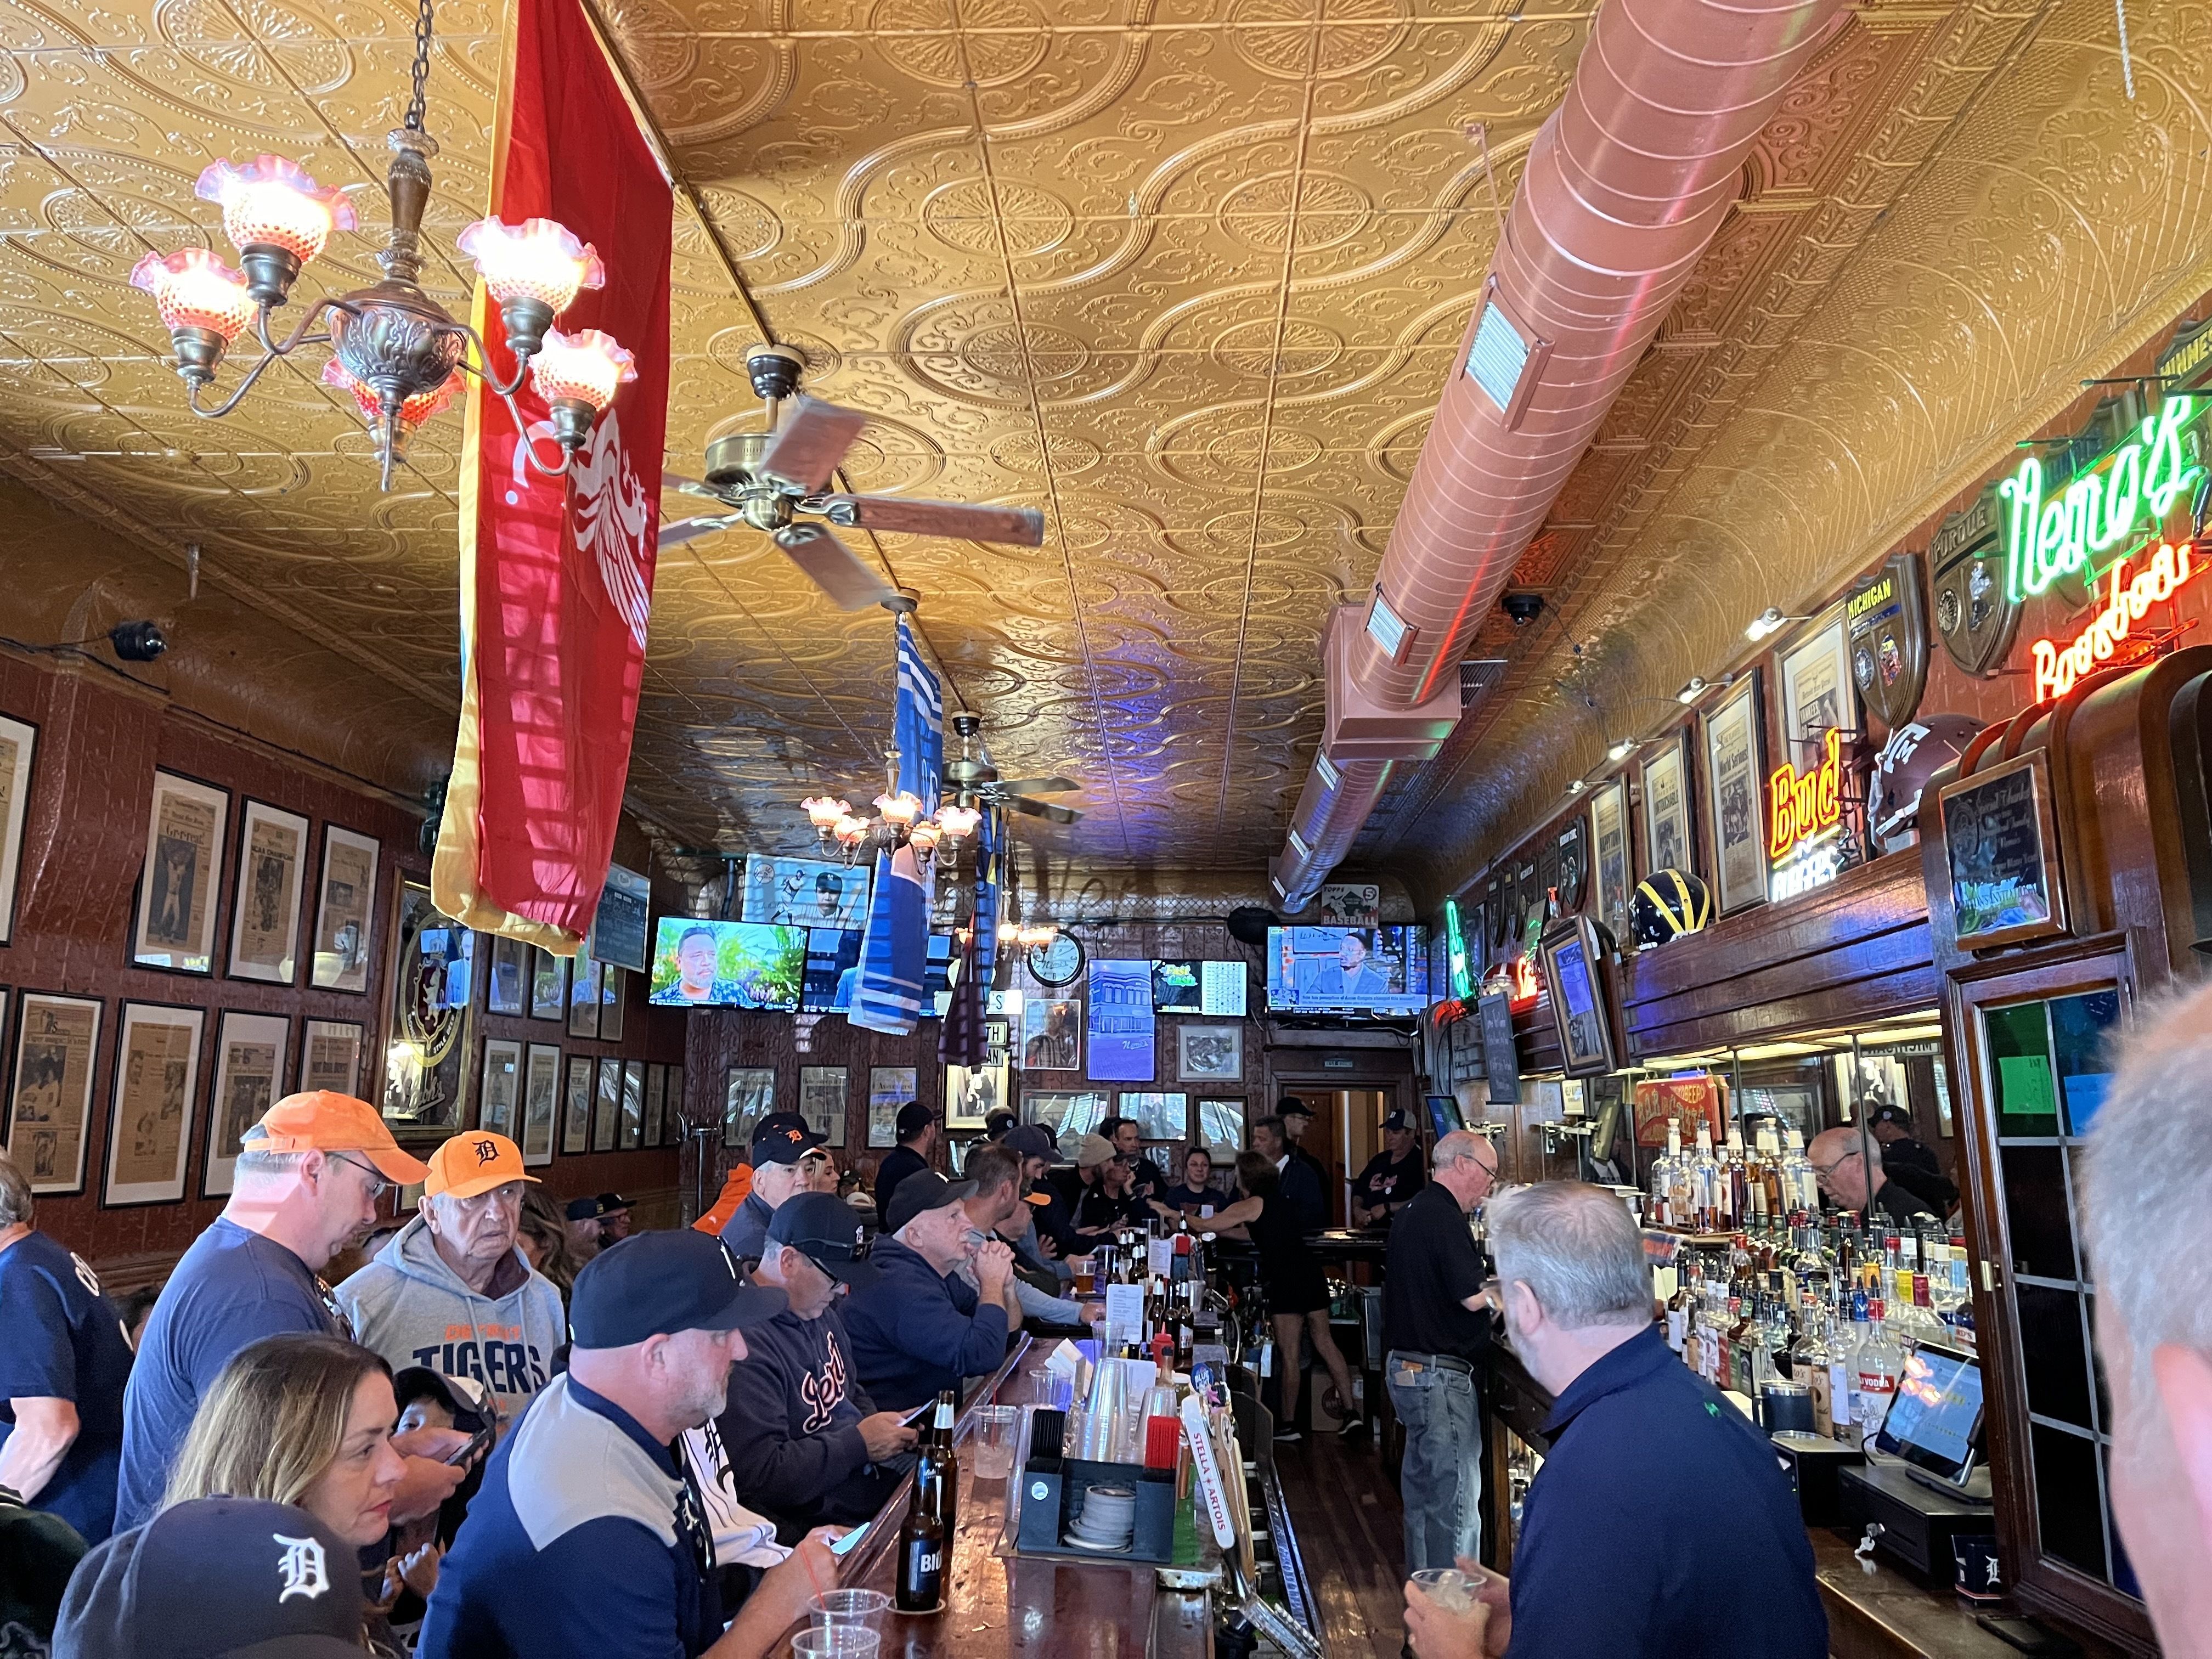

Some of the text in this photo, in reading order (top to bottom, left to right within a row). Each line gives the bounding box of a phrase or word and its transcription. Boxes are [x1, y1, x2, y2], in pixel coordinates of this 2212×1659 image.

[2000, 395, 2201, 603] Nemo's
[1933, 505, 1987, 564] PURDUE
[1848, 578, 1891, 620] MICHIGAN
[1770, 726, 1841, 859] Bud
[1323, 915, 1377, 926] BASEBALL
[433, 1035, 447, 1054] STYLE
[472, 1139, 501, 1167] D
[413, 1340, 546, 1394] TIGERS
[1194, 1372, 1209, 1384] BLUE
[1193, 1432, 1226, 1531] STELLA ARTOIS
[273, 1532, 331, 1604] D
